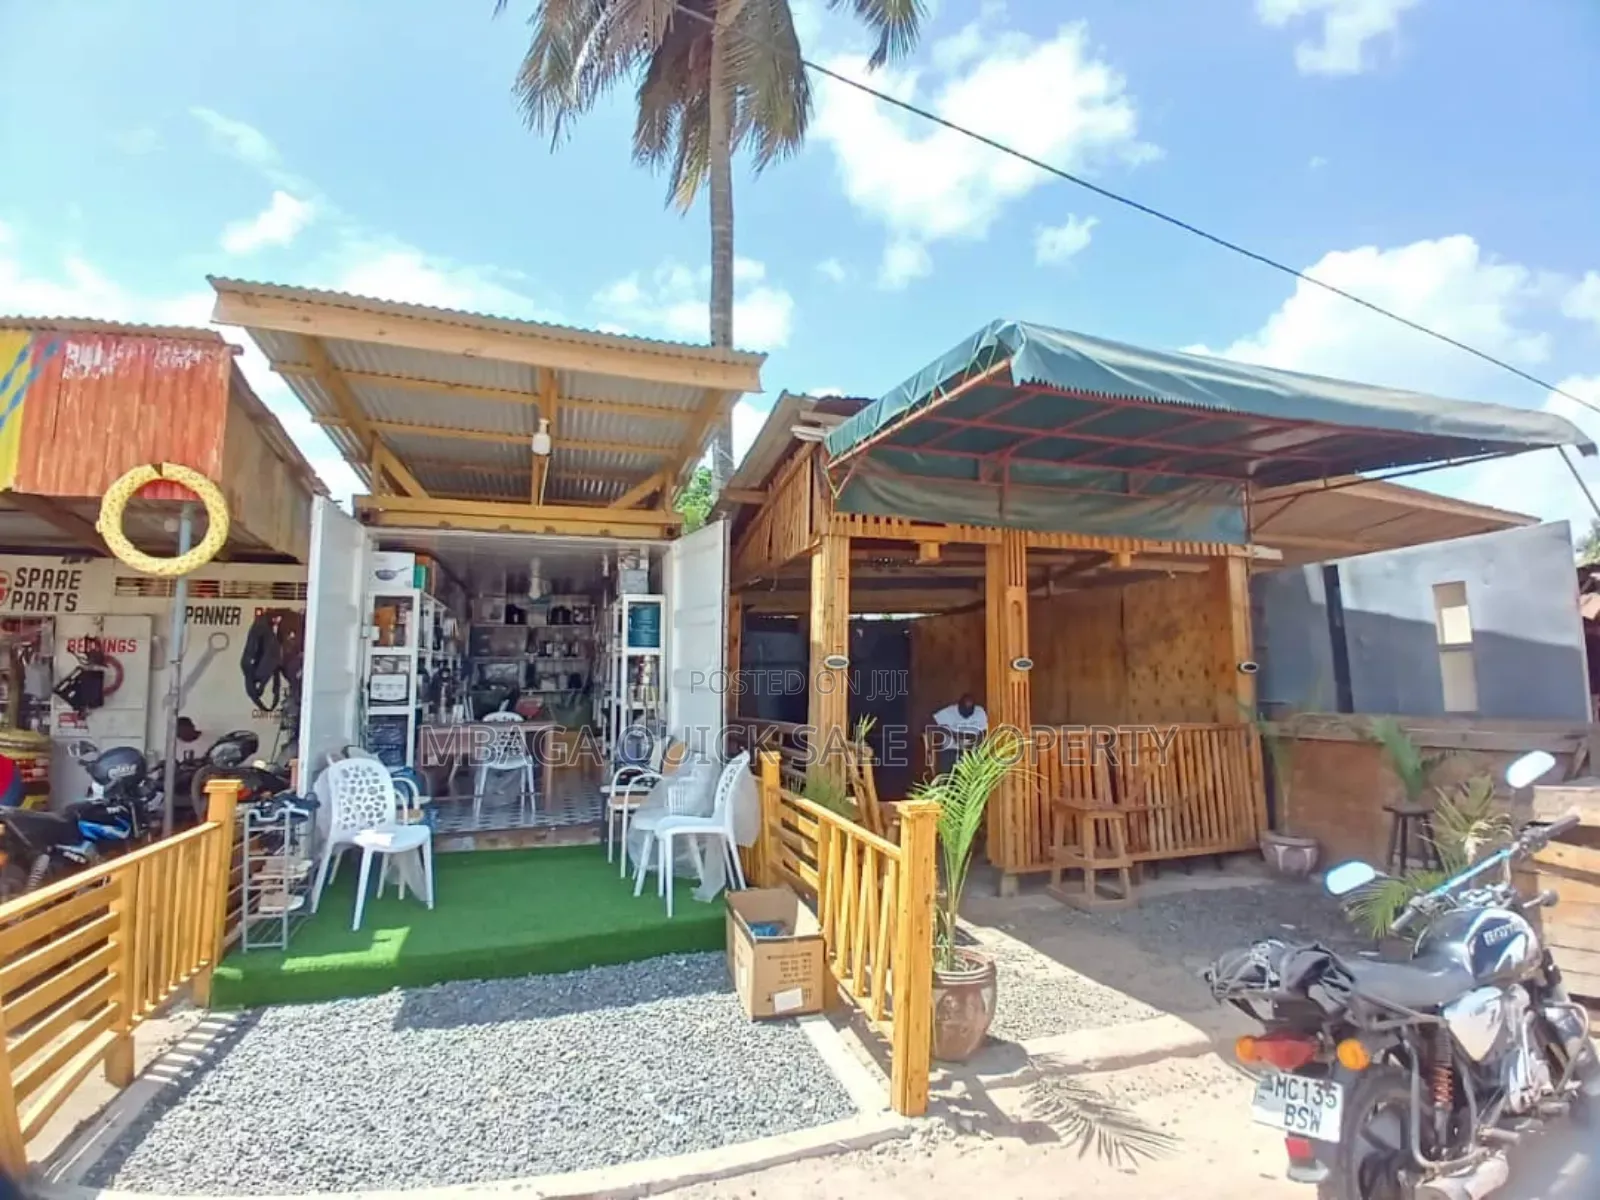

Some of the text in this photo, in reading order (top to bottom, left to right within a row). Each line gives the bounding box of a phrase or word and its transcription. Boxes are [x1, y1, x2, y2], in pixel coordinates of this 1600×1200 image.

[14, 567, 82, 590] SPARE
[11, 590, 79, 612] PARTS
[184, 605, 242, 626] PANNER
[1275, 1074, 1337, 1109] MC135
[1284, 1103, 1321, 1133] BSW
